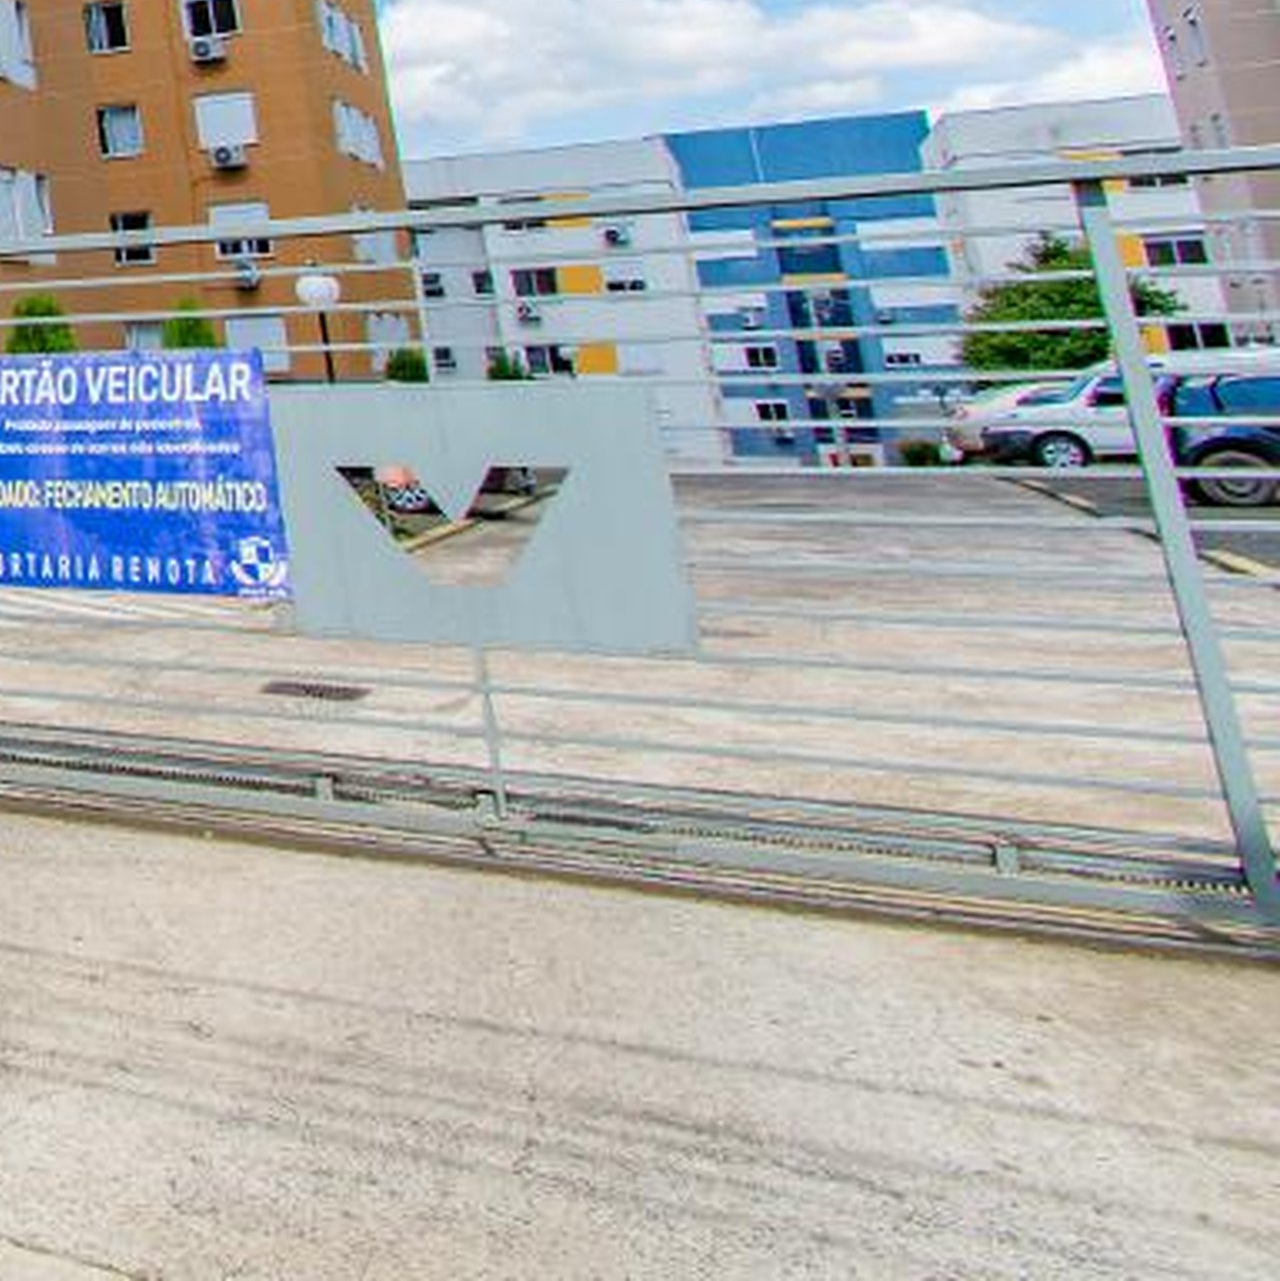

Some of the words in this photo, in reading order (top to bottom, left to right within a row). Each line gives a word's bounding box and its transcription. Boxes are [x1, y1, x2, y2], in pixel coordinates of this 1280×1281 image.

[85, 362, 251, 404] VEICULAR
[44, 479, 153, 510] FECHAMENTO
[112, 556, 218, 585] REMOTA
